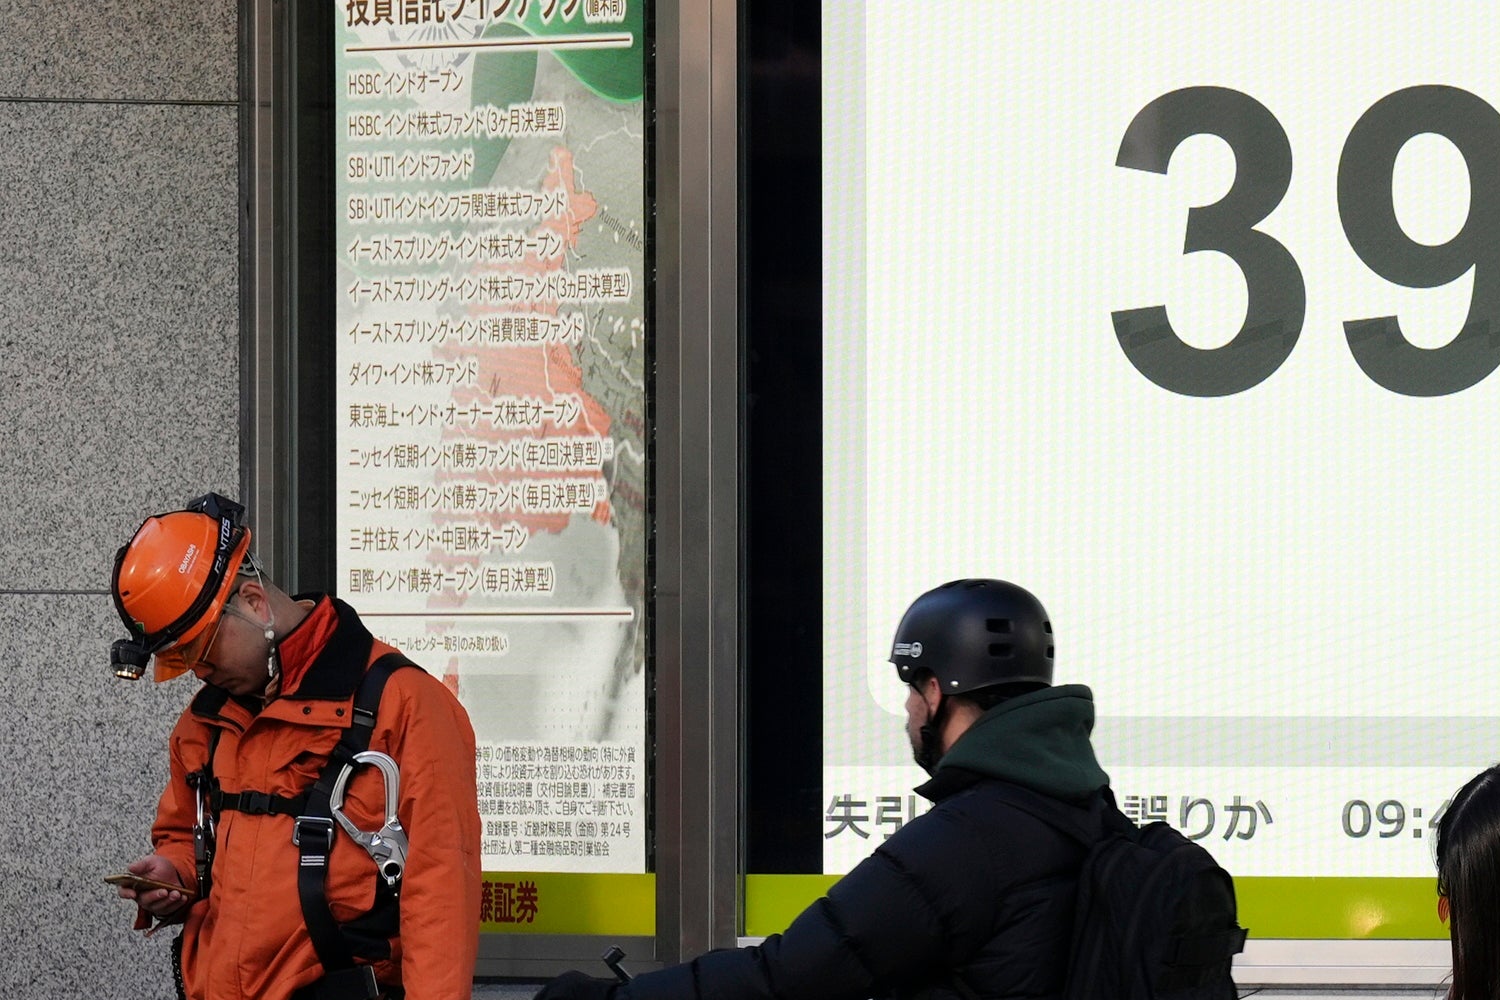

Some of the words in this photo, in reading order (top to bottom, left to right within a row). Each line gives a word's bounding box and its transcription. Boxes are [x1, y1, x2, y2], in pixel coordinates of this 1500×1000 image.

[348, 73, 381, 95] HSBC
[384, 69, 464, 93] インドオープン
[348, 114, 381, 137] HSBC
[348, 156, 394, 178] SBI・UTI
[397, 154, 473, 177] インドファンド
[349, 234, 561, 262] イーストスプリング・インド株式オープン
[349, 317, 582, 344] イーストスプリング・インド消費関連ファンド
[349, 360, 476, 385] ダイワ・インド株ファンド
[349, 401, 579, 427] 東京海上・インド・オーナーズ株式オープン
[349, 527, 399, 551] 三井住友
[402, 526, 528, 550] インド・中国株オープン
[178, 543, 197, 574] OBAYASHI
[349, 566, 554, 593] 国際インド債券オープン(毎月決算型)
